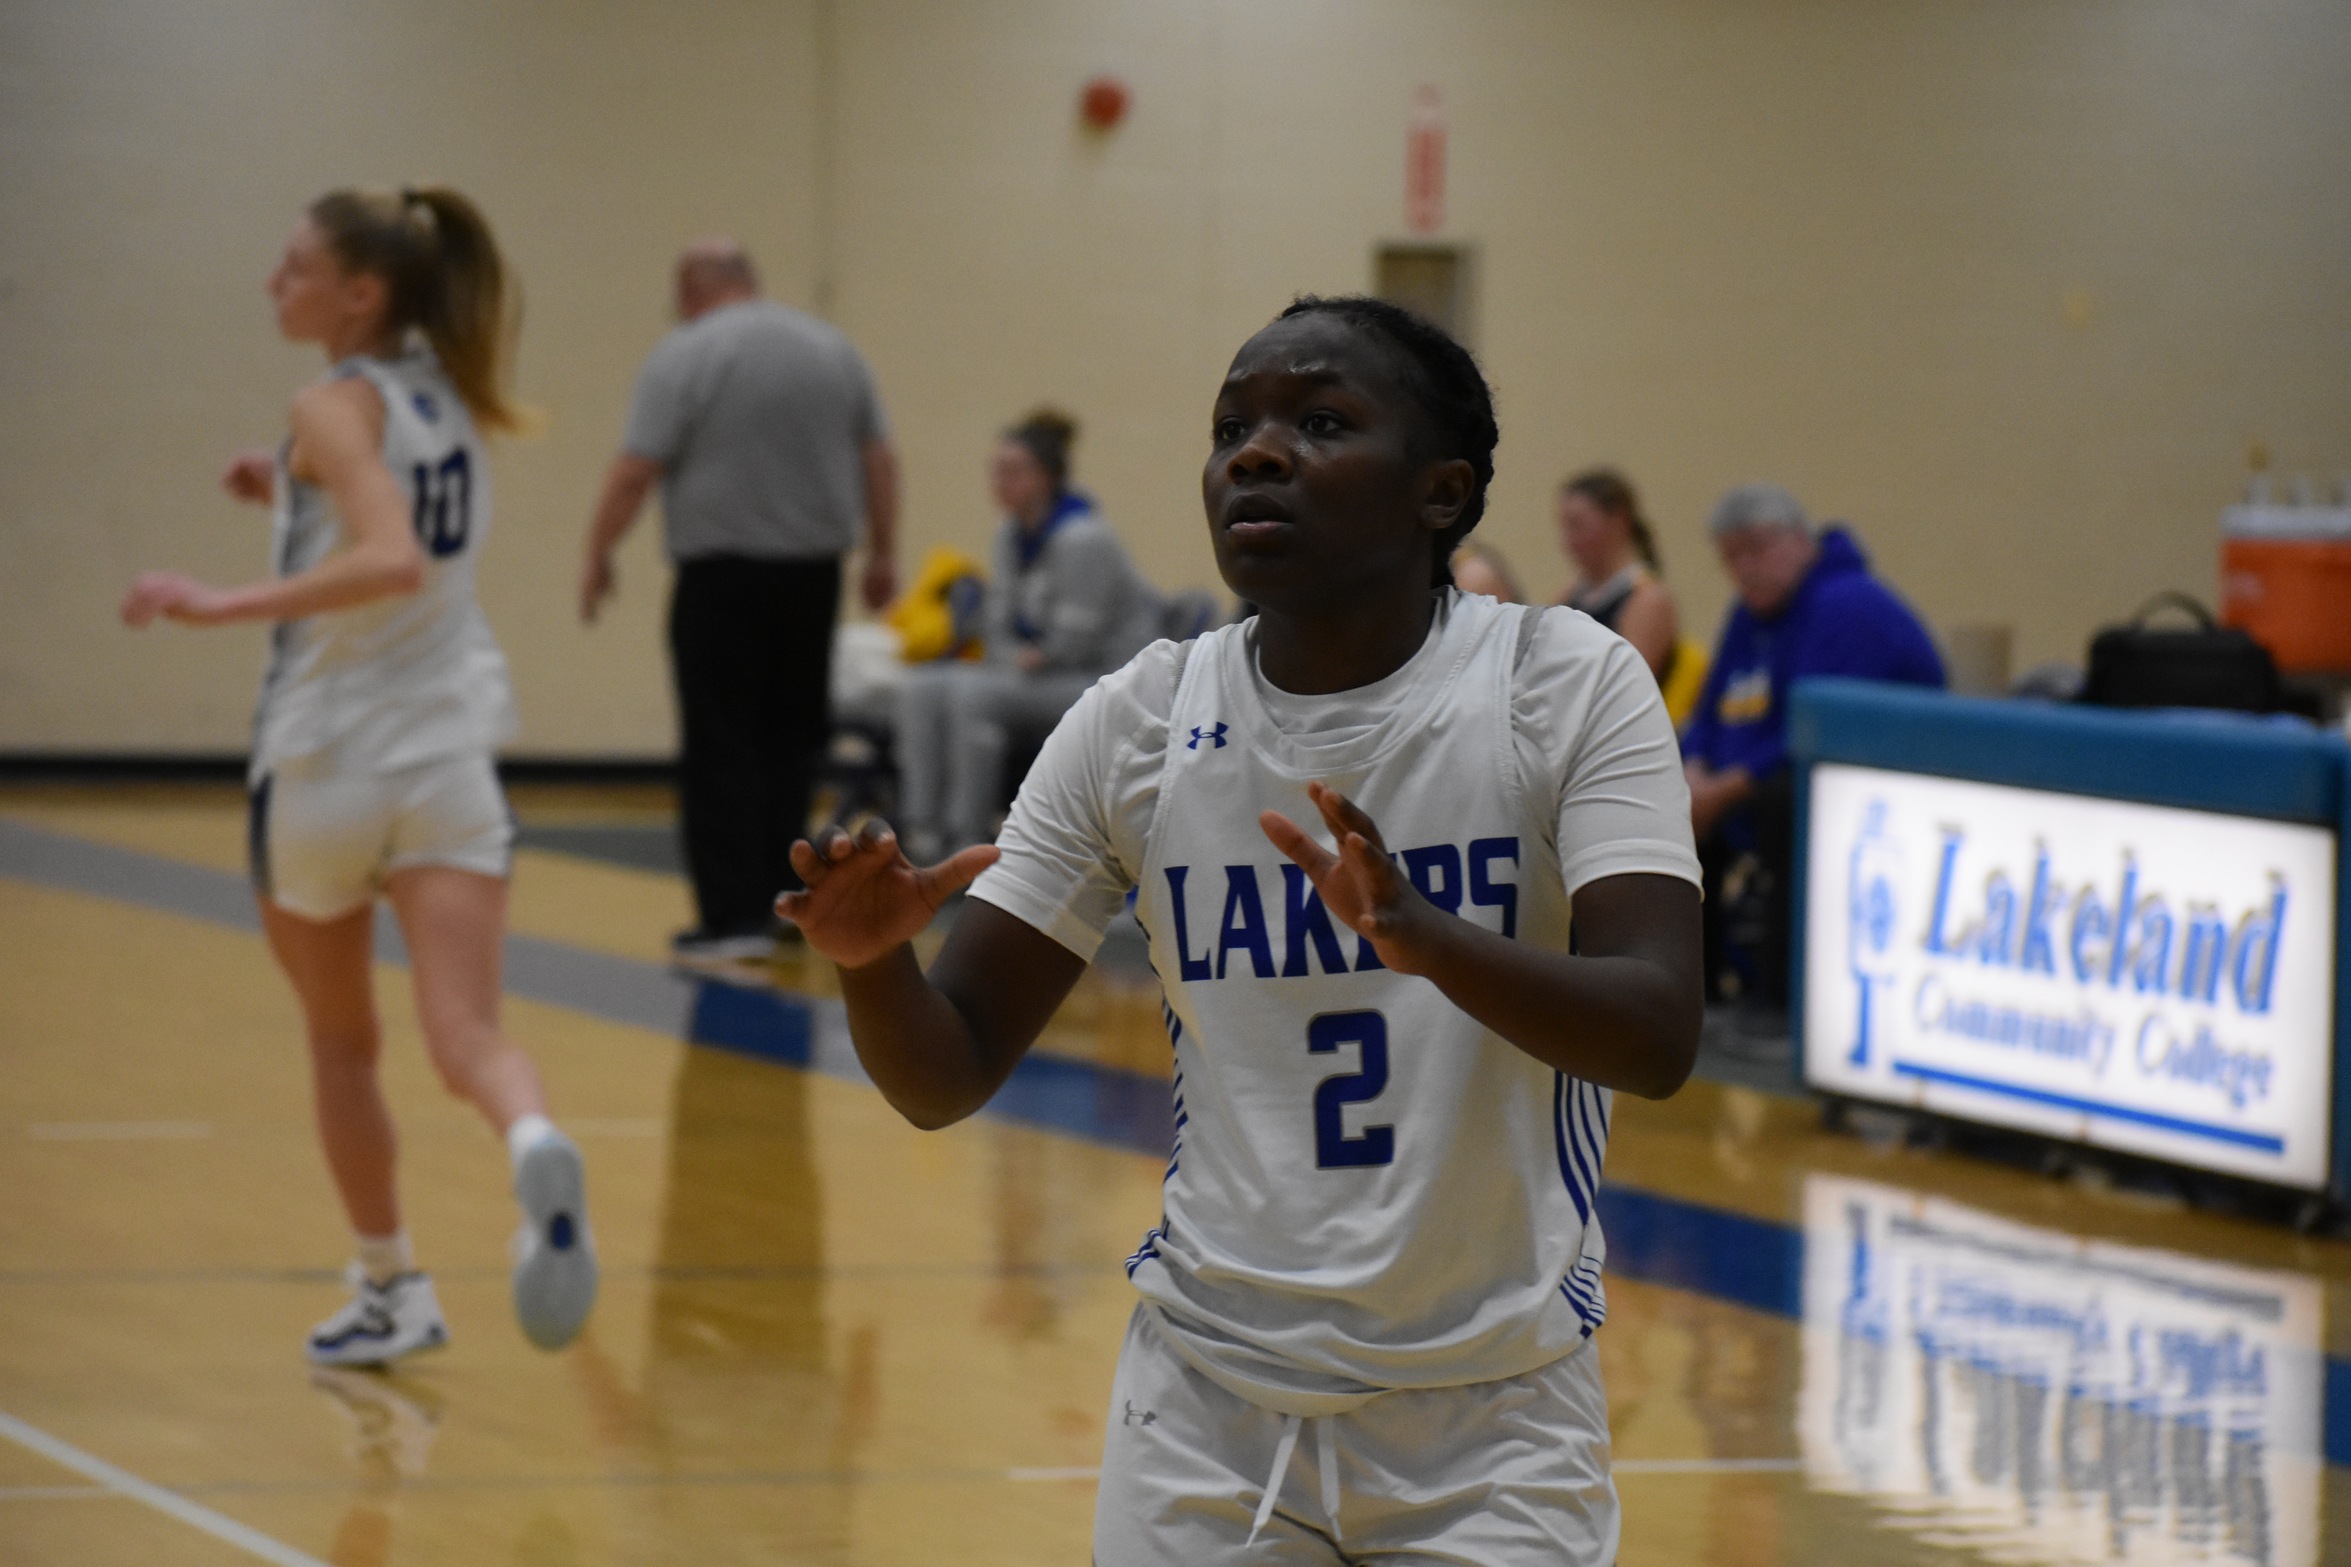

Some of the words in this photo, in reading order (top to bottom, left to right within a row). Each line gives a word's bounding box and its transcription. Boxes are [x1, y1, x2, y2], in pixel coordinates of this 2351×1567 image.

[1921, 823, 2288, 1014] Lakeland
[1307, 1008, 1395, 1170] 2
[1915, 972, 2114, 1076] Community
[2137, 1014, 2272, 1108] College
